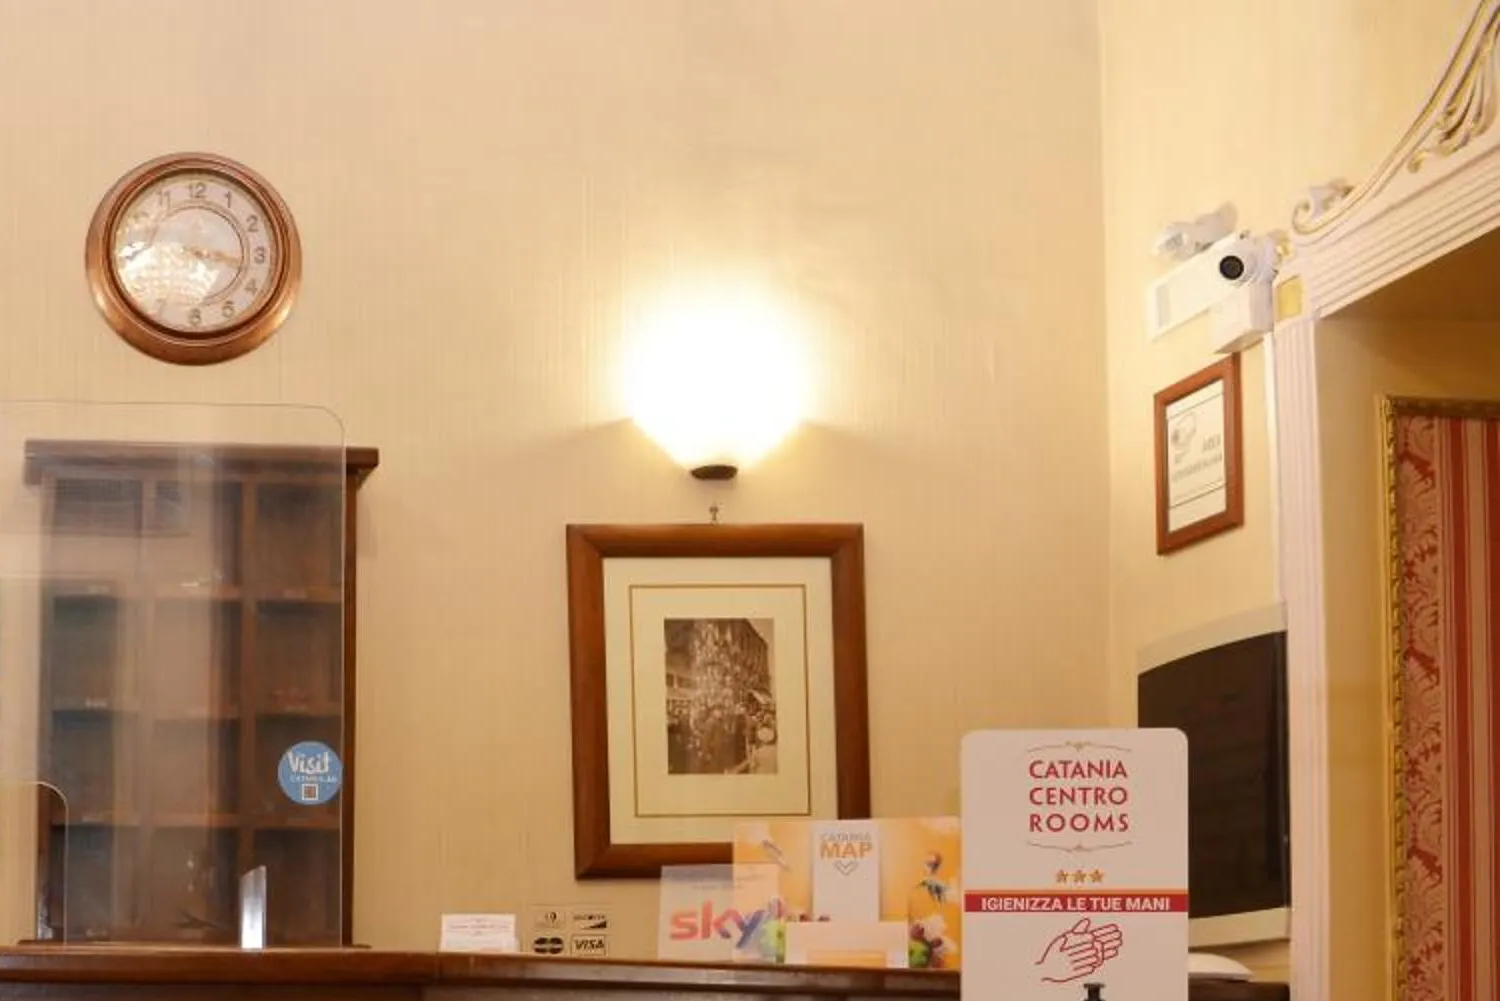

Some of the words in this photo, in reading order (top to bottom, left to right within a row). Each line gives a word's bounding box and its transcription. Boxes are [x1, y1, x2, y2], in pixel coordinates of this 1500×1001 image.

[156, 188, 172, 210] 11
[188, 182, 207, 200] 12
[224, 191, 232, 209] 1
[246, 214, 259, 233] 2
[254, 246, 266, 264] 3
[244, 279, 258, 295] 4
[287, 751, 329, 775] Visit
[1028, 759, 1129, 779] CATANIA
[1028, 786, 1129, 806] CENTRO
[1028, 812, 1130, 833] ROOMS
[820, 841, 873, 860] MAP
[980, 897, 1063, 912] IGIENIZZA
[1066, 897, 1087, 912] LE
[1089, 897, 1123, 912] TUE
[1125, 897, 1171, 912] MANI
[669, 899, 766, 949] sky
[573, 938, 605, 951] VISA
